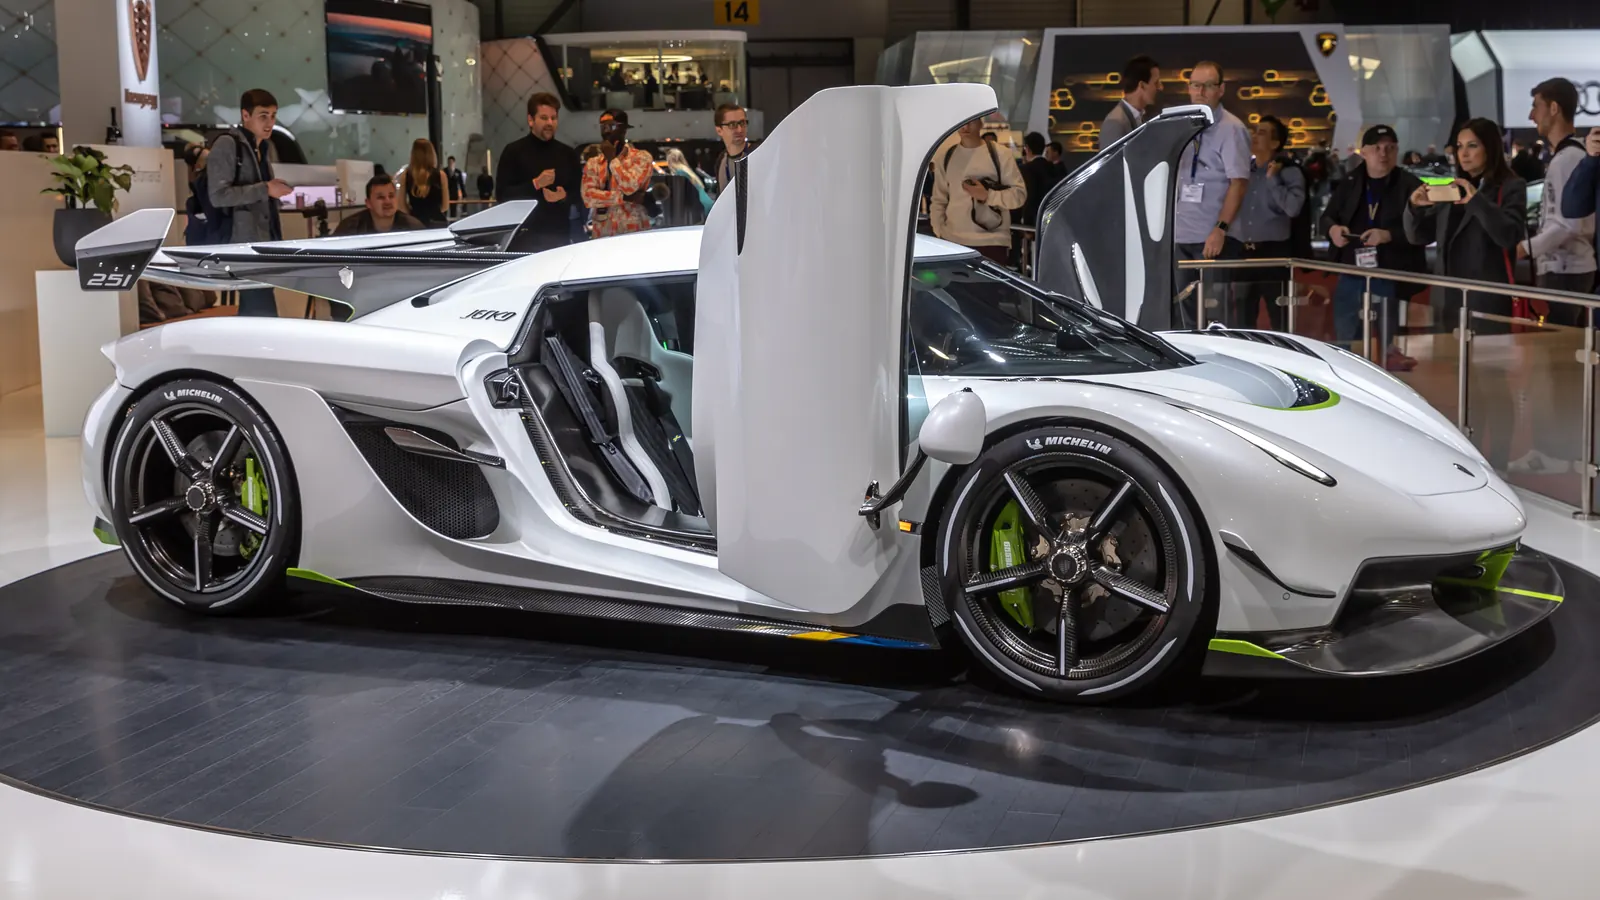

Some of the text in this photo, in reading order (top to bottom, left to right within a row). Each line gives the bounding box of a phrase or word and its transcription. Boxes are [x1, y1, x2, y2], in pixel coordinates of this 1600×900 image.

[725, 1, 748, 22] 14
[86, 273, 132, 287] 251
[177, 389, 223, 403] MICHELIN
[1045, 436, 1112, 454] MICHELIN
